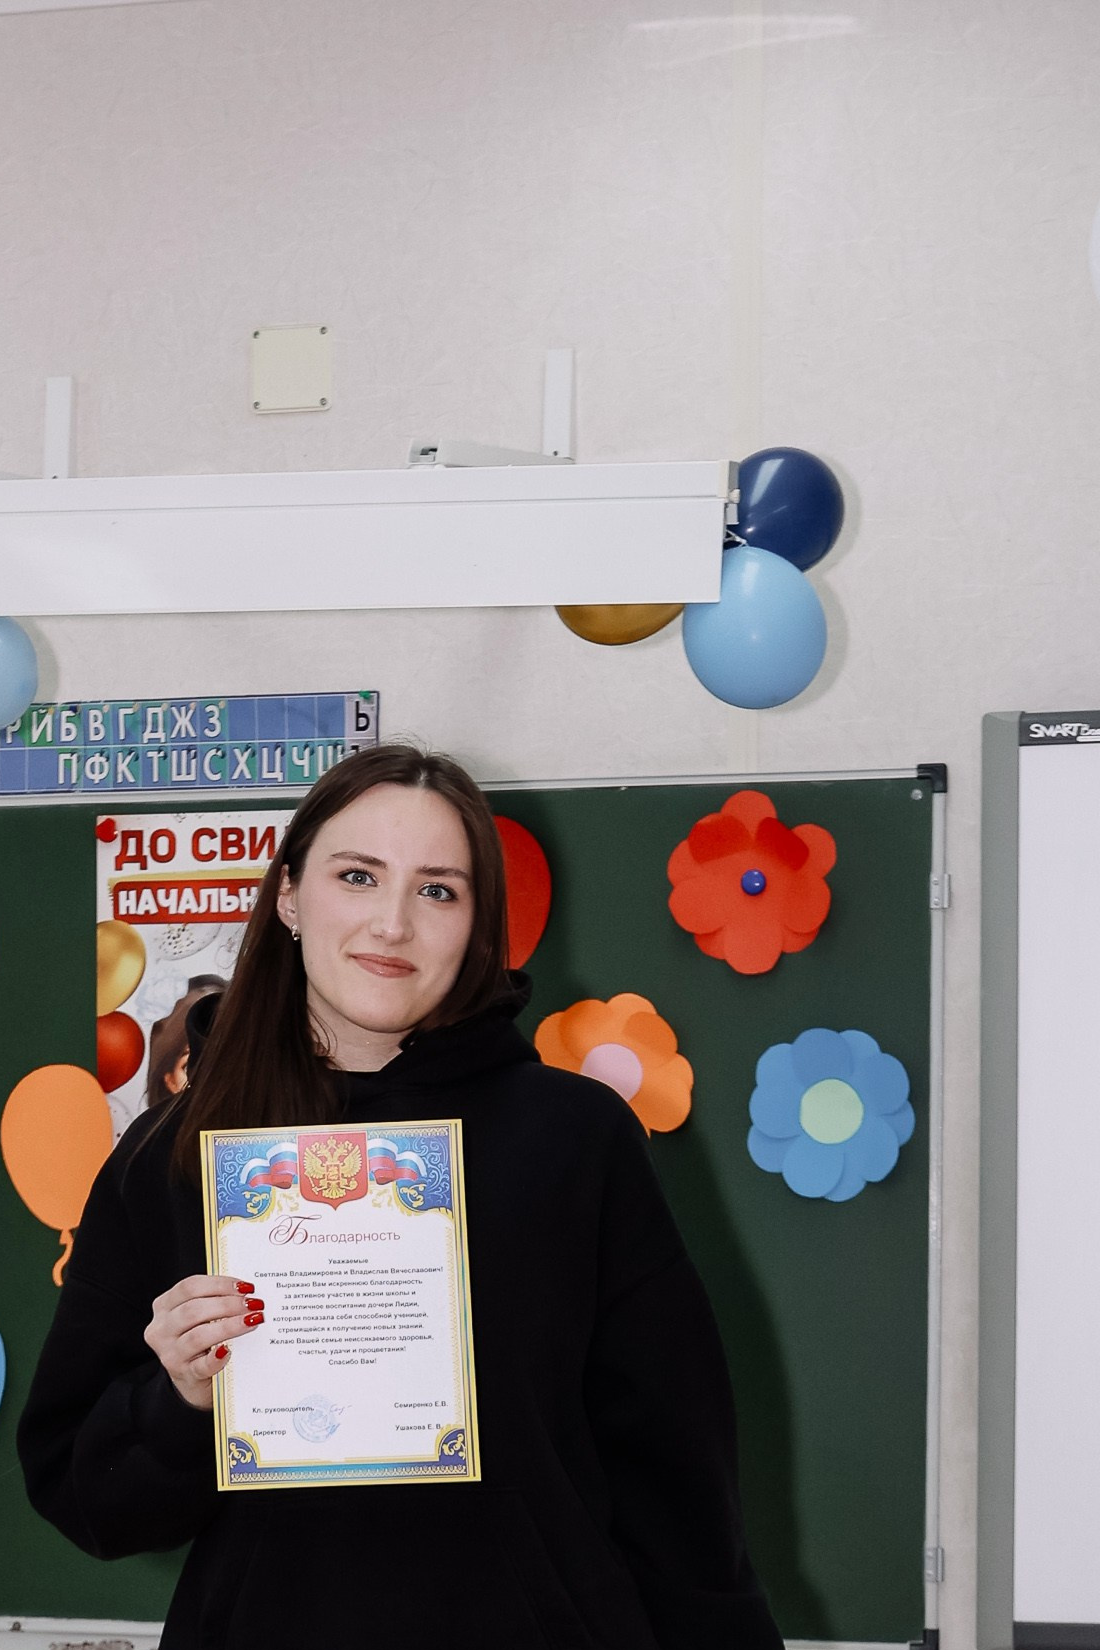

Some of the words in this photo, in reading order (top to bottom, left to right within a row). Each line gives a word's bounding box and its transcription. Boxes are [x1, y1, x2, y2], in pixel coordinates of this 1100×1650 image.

[115, 828, 177, 871] ДО
[191, 825, 290, 863] СВИ
[268, 1214, 401, 1246] Благодарность
[350, 1268, 389, 1276] Владислав
[276, 1281, 311, 1289] Выражаю
[370, 1279, 423, 1287] благодарность
[327, 1291, 355, 1299] участие
[273, 1315, 301, 1323] которая
[354, 1312, 392, 1320] способной
[332, 1325, 372, 1333] получению
[269, 1337, 295, 1345] Желаю
[296, 1336, 320, 1344] Вашей
[328, 1358, 359, 1366] Спасибо
[360, 1357, 377, 1365] Вам!
[264, 1405, 315, 1414] руководитель
[395, 1424, 426, 1432] Ушакова
[253, 1429, 287, 1437] Директор
